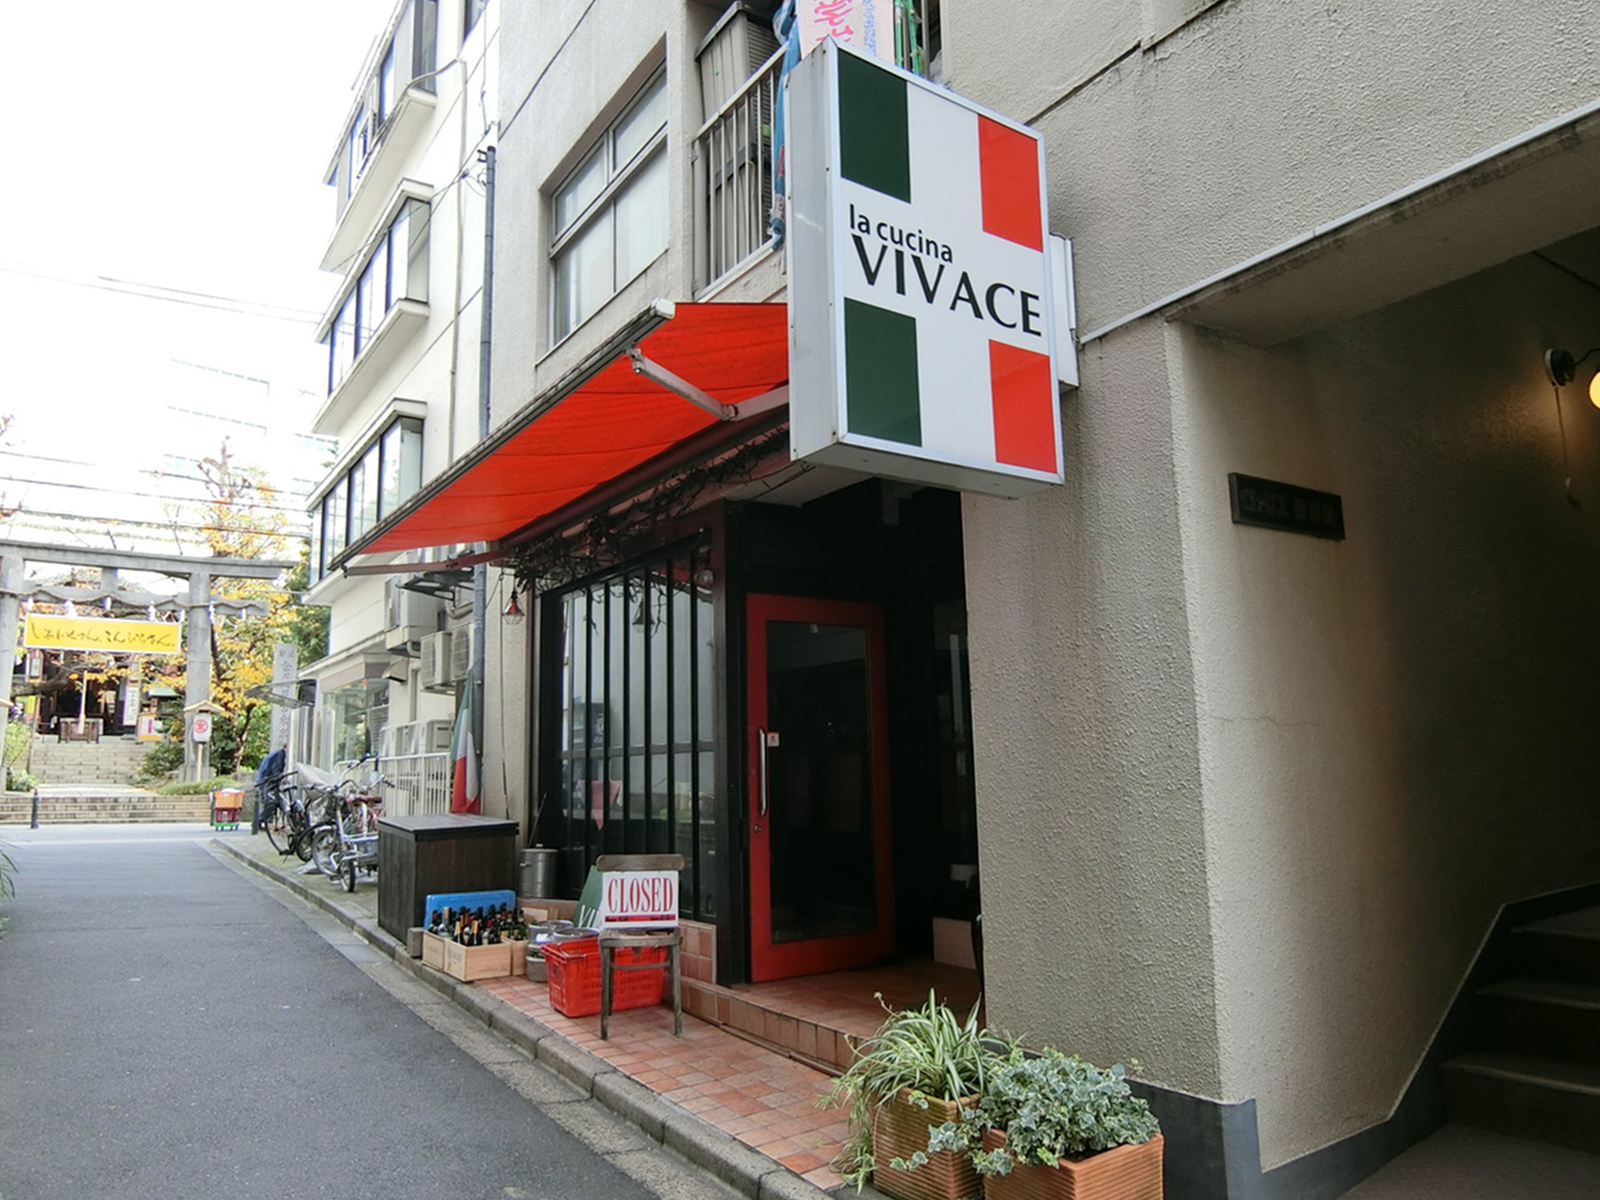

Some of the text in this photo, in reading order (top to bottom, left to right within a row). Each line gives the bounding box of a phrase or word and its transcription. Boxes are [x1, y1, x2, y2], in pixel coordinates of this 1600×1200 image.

[850, 203, 953, 263] la cucina
[851, 233, 1042, 337] VIVACE
[607, 877, 674, 914] CLOSED
